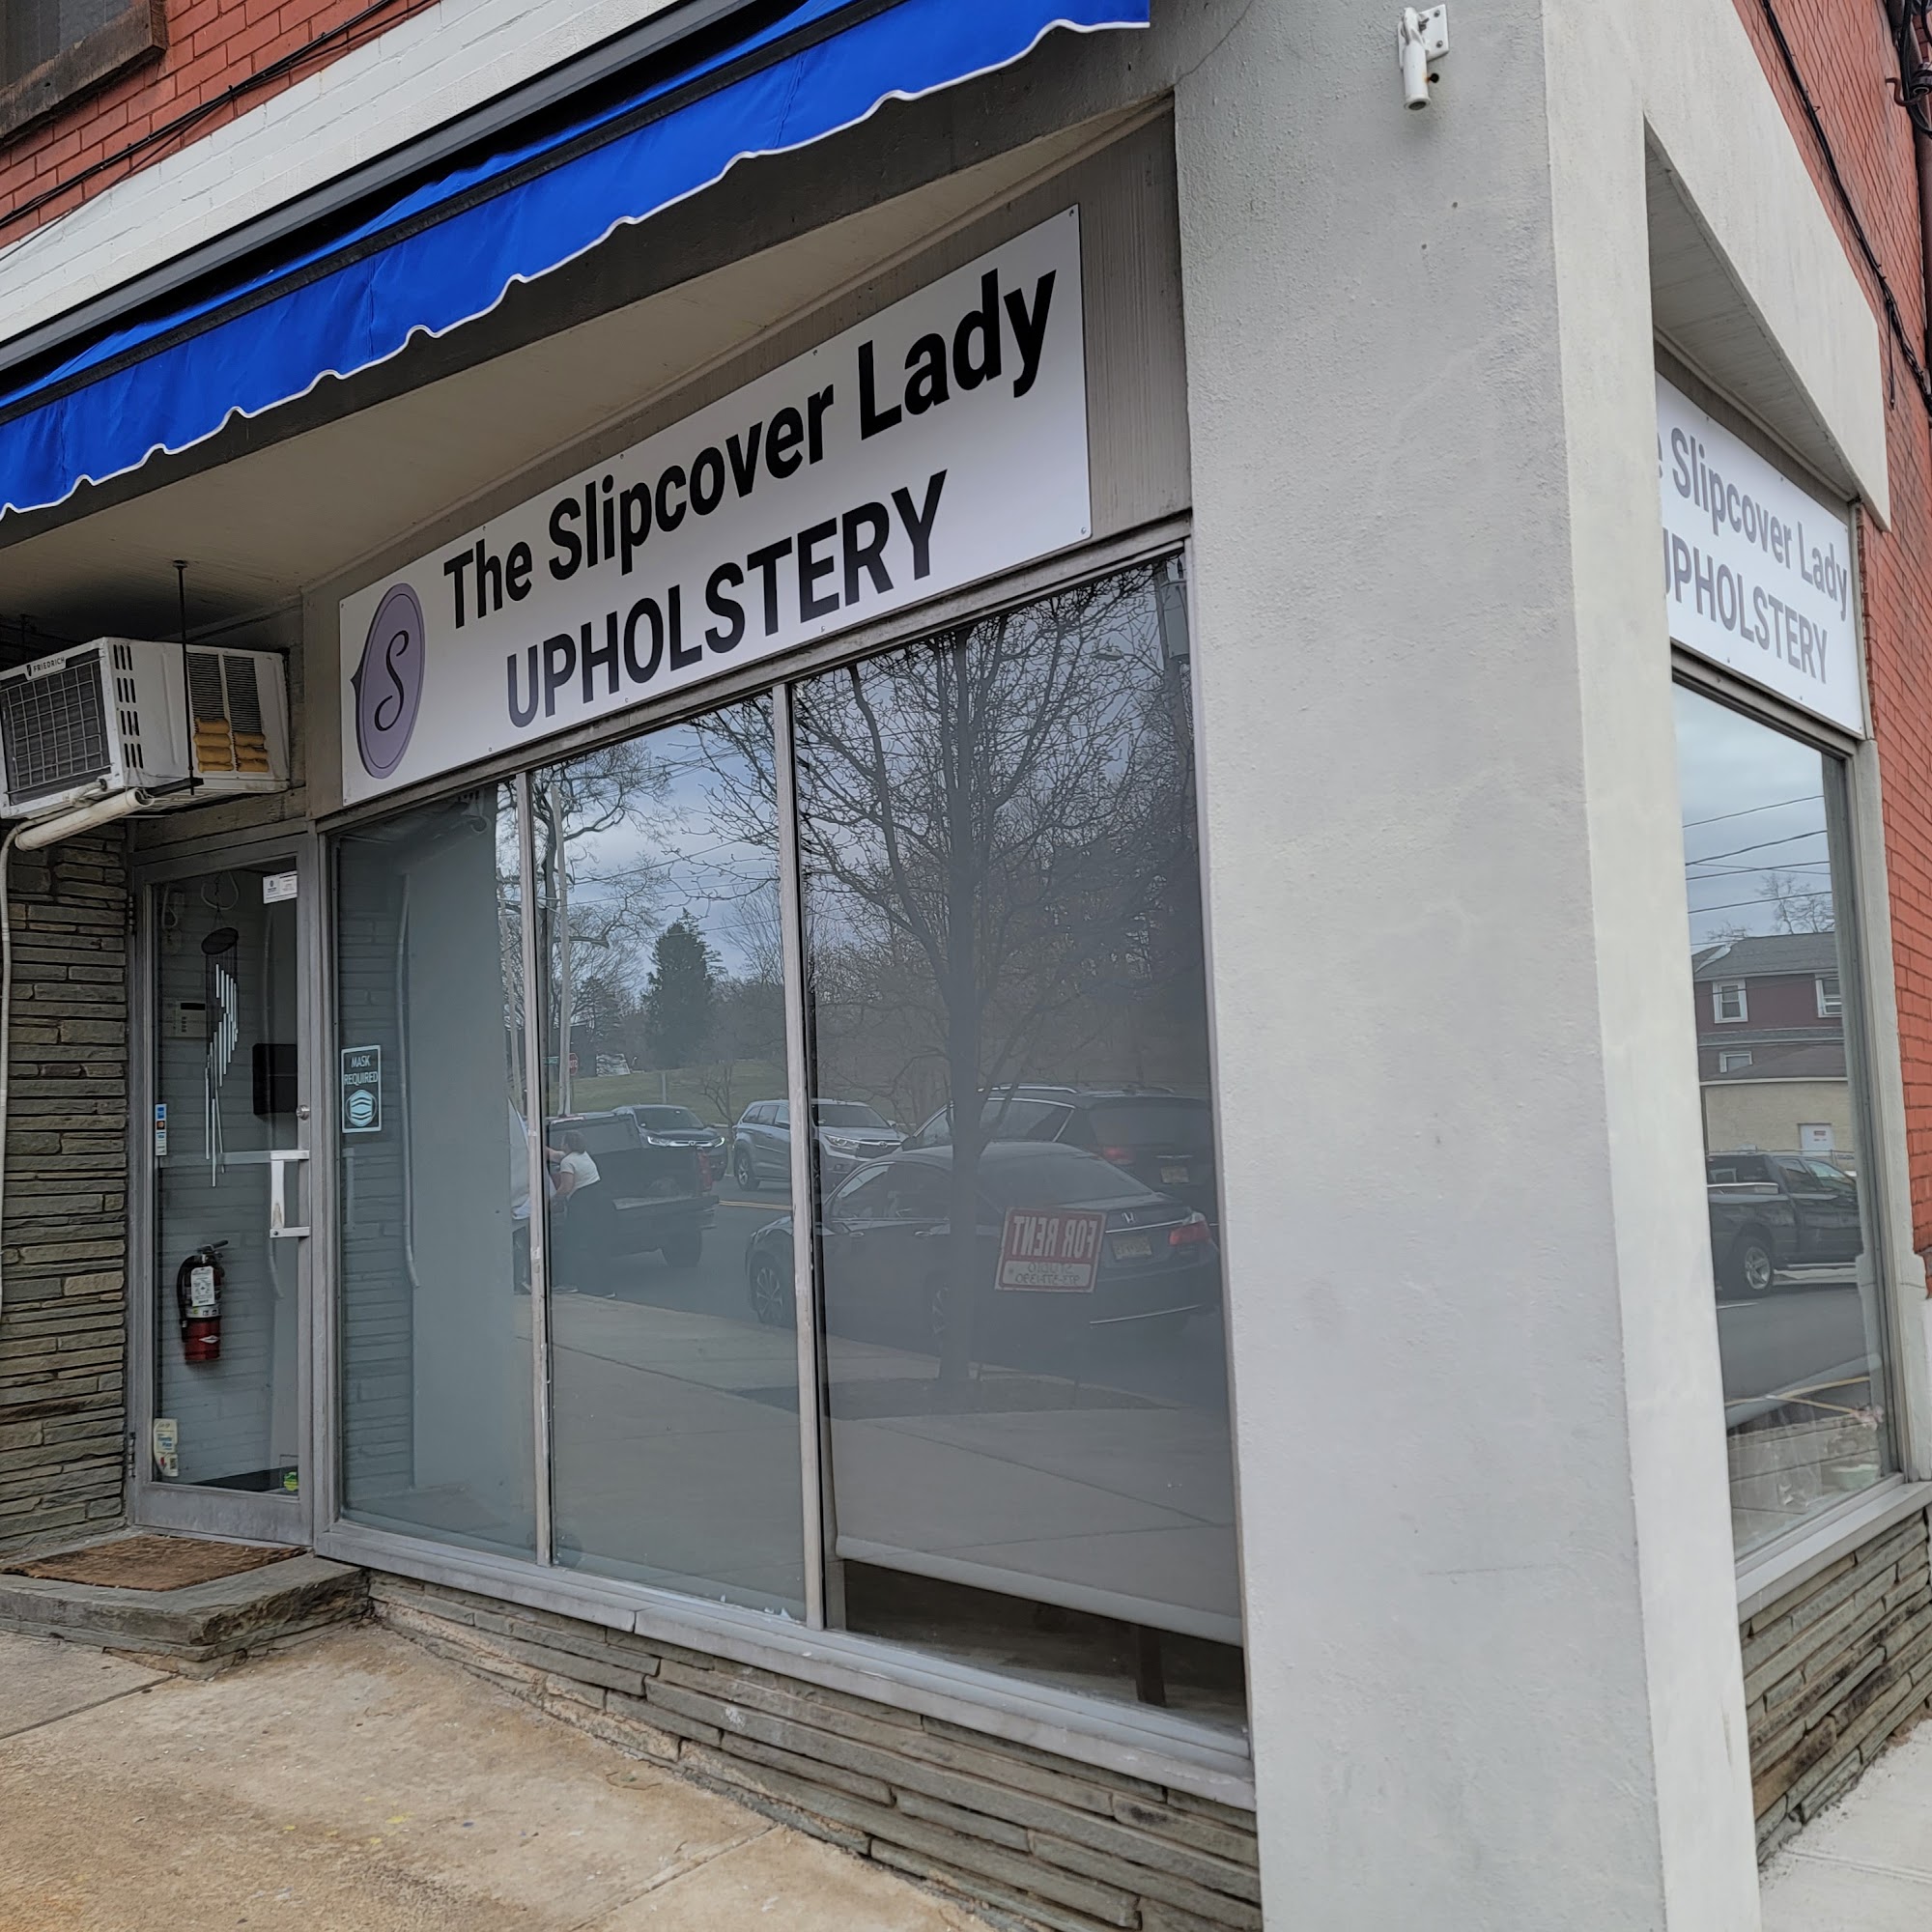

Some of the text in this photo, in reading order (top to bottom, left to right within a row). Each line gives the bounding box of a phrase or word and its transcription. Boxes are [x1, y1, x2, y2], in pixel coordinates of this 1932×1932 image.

[443, 269, 1057, 629] The Slipcover Lady
[1670, 427, 1792, 570] Slipcover
[1797, 521, 1848, 622] Lady
[507, 469, 949, 729] UPHOLSTERY
[33, 657, 64, 672] FRIEDRICH
[344, 1071, 378, 1086] REQUIRED
[352, 1055, 371, 1067] MASK
